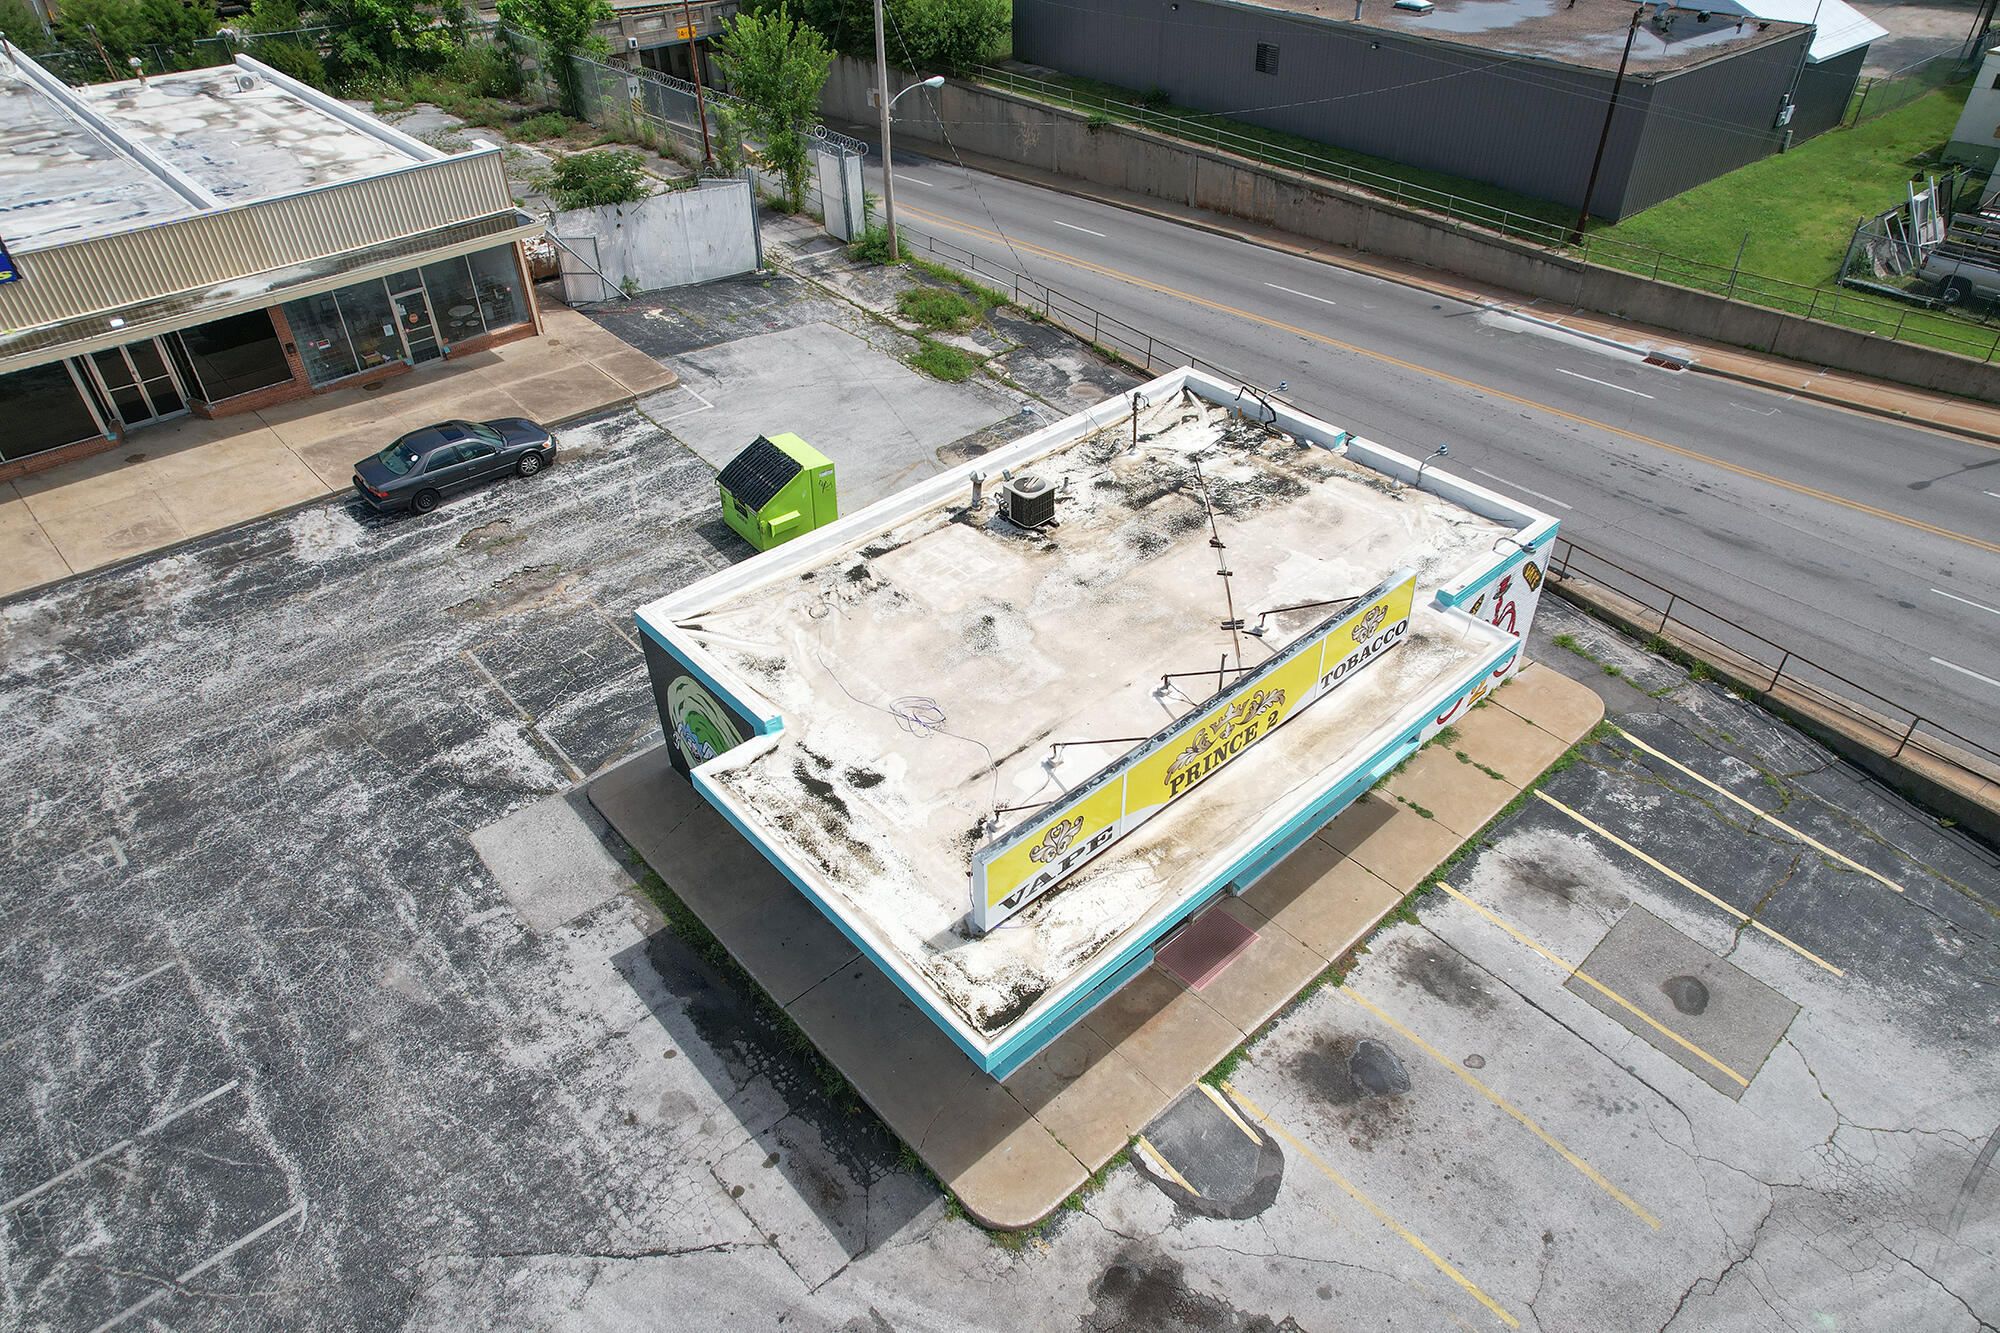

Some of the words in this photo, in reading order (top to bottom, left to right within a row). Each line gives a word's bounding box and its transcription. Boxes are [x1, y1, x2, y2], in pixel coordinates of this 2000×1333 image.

[1321, 619, 1407, 690] TOBACCO
[1169, 721, 1259, 799] PRINCE
[1266, 710, 1279, 730] 2
[998, 826, 1113, 910] VAPE
